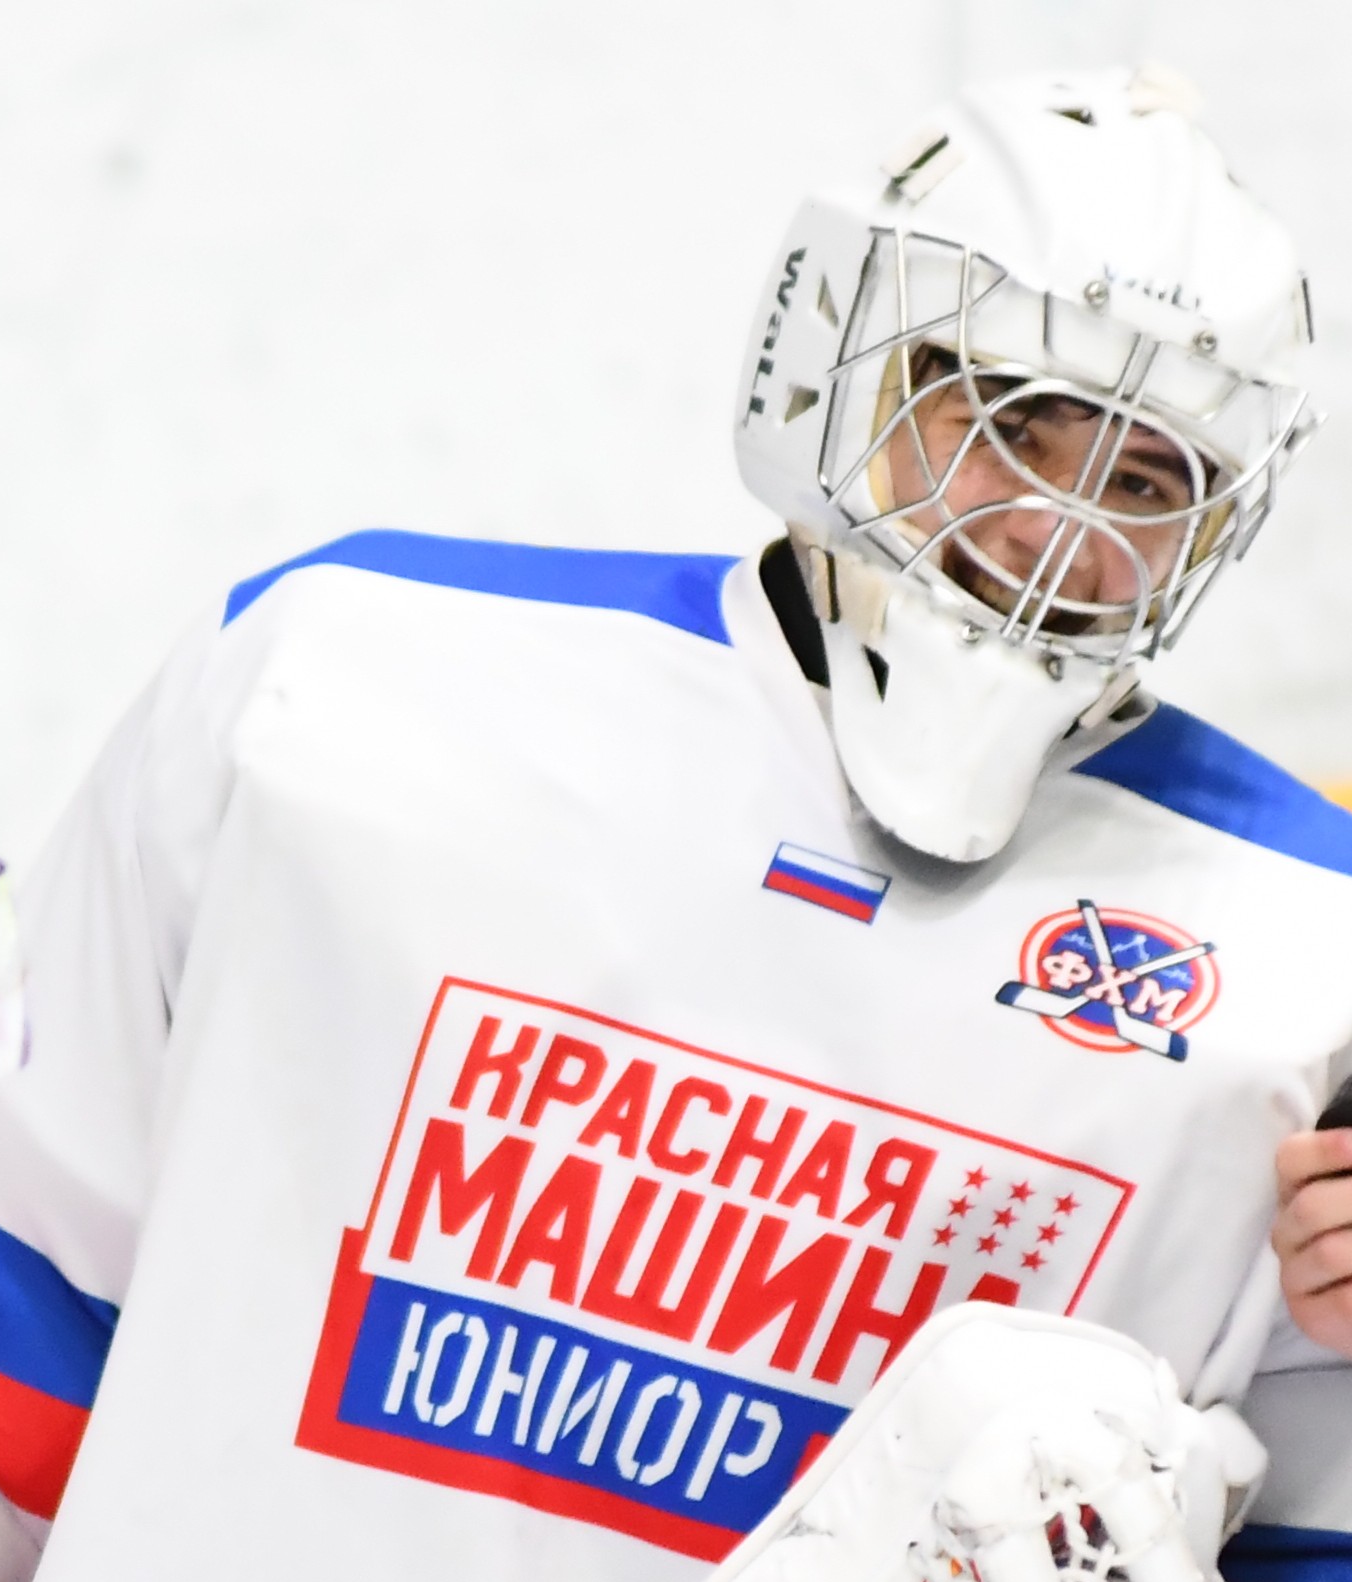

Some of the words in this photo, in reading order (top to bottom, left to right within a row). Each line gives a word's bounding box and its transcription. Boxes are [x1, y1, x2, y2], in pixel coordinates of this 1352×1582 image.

[1041, 948, 1189, 1022] ФХМ
[449, 1015, 939, 1240] КРАСНАЯ
[389, 1117, 1023, 1384] МАШИН
[382, 1301, 784, 1501] ЮНИОР
